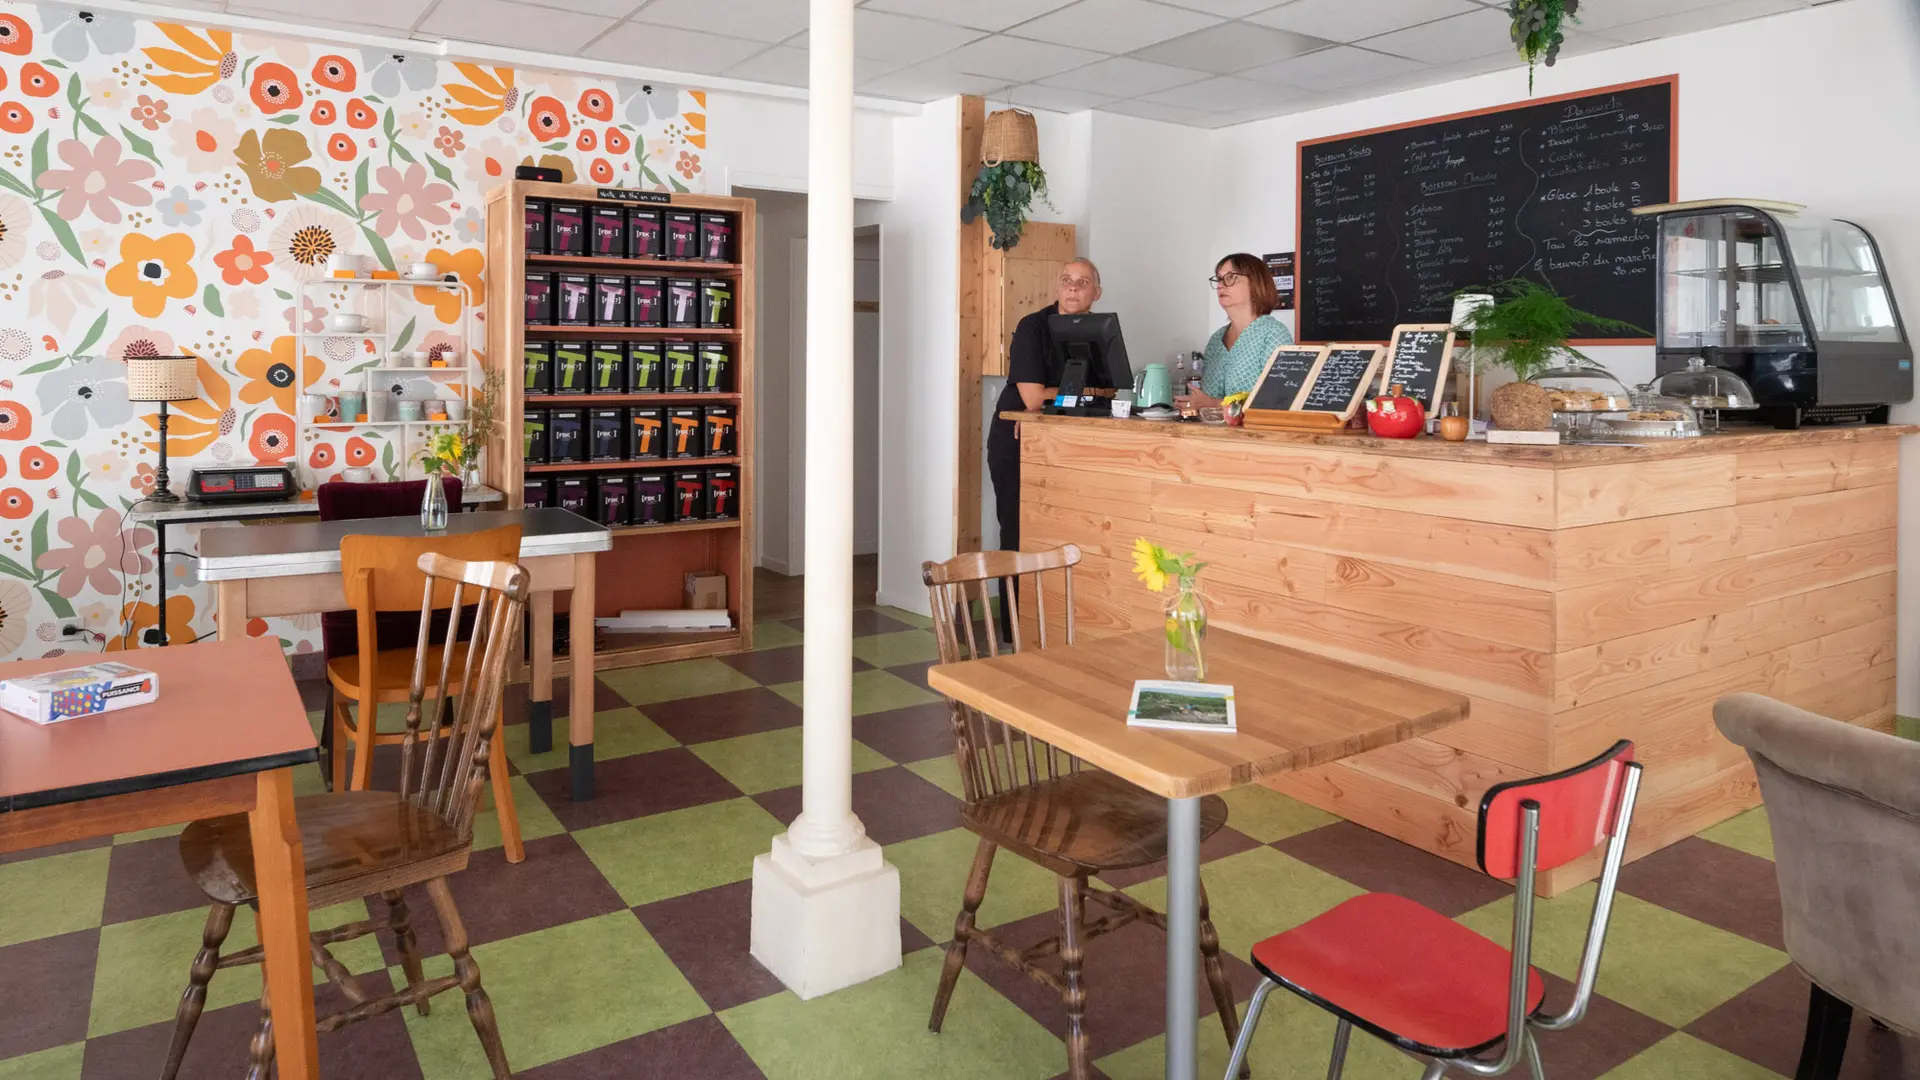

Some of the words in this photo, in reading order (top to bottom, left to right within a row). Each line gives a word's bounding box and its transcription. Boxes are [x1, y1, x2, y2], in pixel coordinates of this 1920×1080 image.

[1617, 113, 1640, 123] 3,00
[1547, 134, 1582, 147] Dessert
[1641, 123, 1664, 133] 3,00
[1548, 149, 1586, 163] Cookie
[1420, 179, 1458, 194] Boissons
[1547, 188, 1578, 201] Glace
[1594, 181, 1620, 194] boule
[1629, 181, 1641, 190] 3
[619, 191, 627, 199] de
[628, 191, 640, 200] thé
[1583, 201, 1593, 212] 2
[1594, 197, 1626, 210] boules
[1631, 195, 1642, 206] 5
[1582, 219, 1592, 228] 3
[1595, 214, 1628, 227] boules
[1542, 237, 1566, 251] Tous
[1594, 228, 1650, 245] samedis
[1549, 252, 1591, 270] brunch
[1593, 252, 1610, 266] du
[102, 686, 140, 698] PUISSANCE
[140, 679, 151, 693] 4
